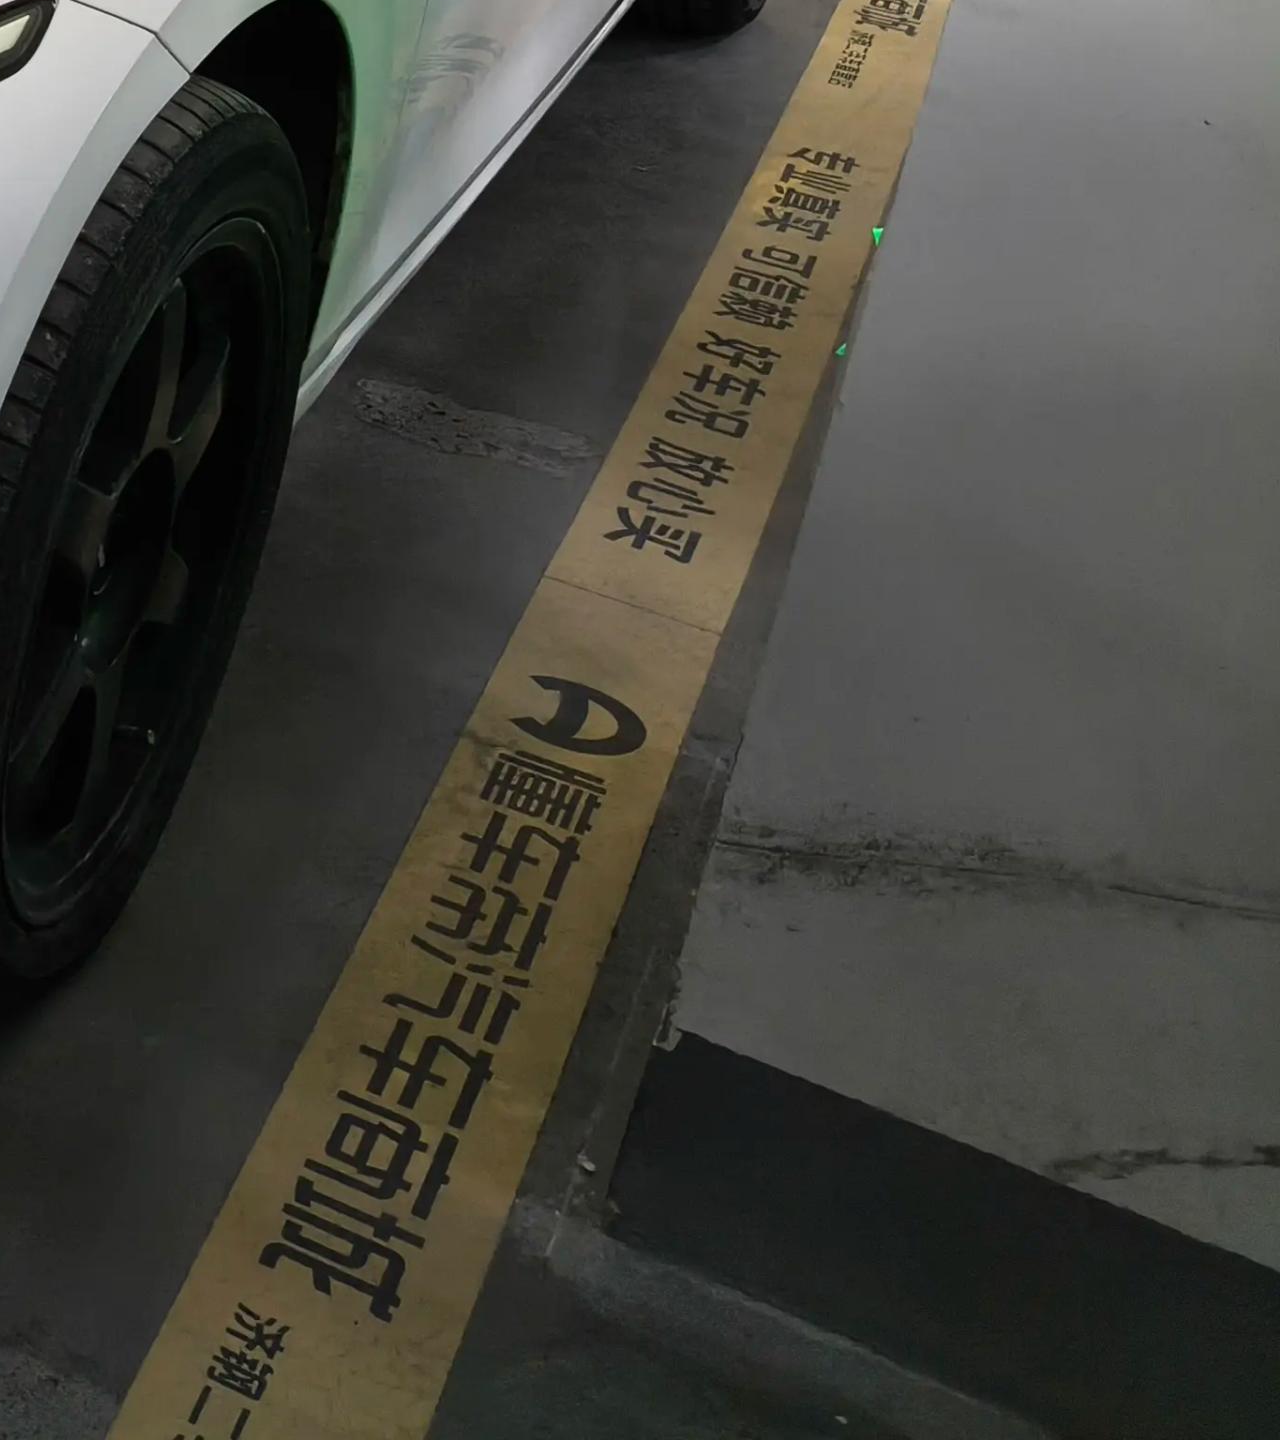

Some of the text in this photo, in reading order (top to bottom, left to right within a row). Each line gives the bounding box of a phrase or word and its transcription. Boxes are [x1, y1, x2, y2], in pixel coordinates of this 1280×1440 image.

[604, 146, 860, 564] 专业真实 可信赖 好车况 放心买
[259, 750, 607, 1323] 懂车帝汽车商城
[172, 1302, 291, 1440] 济钢二
